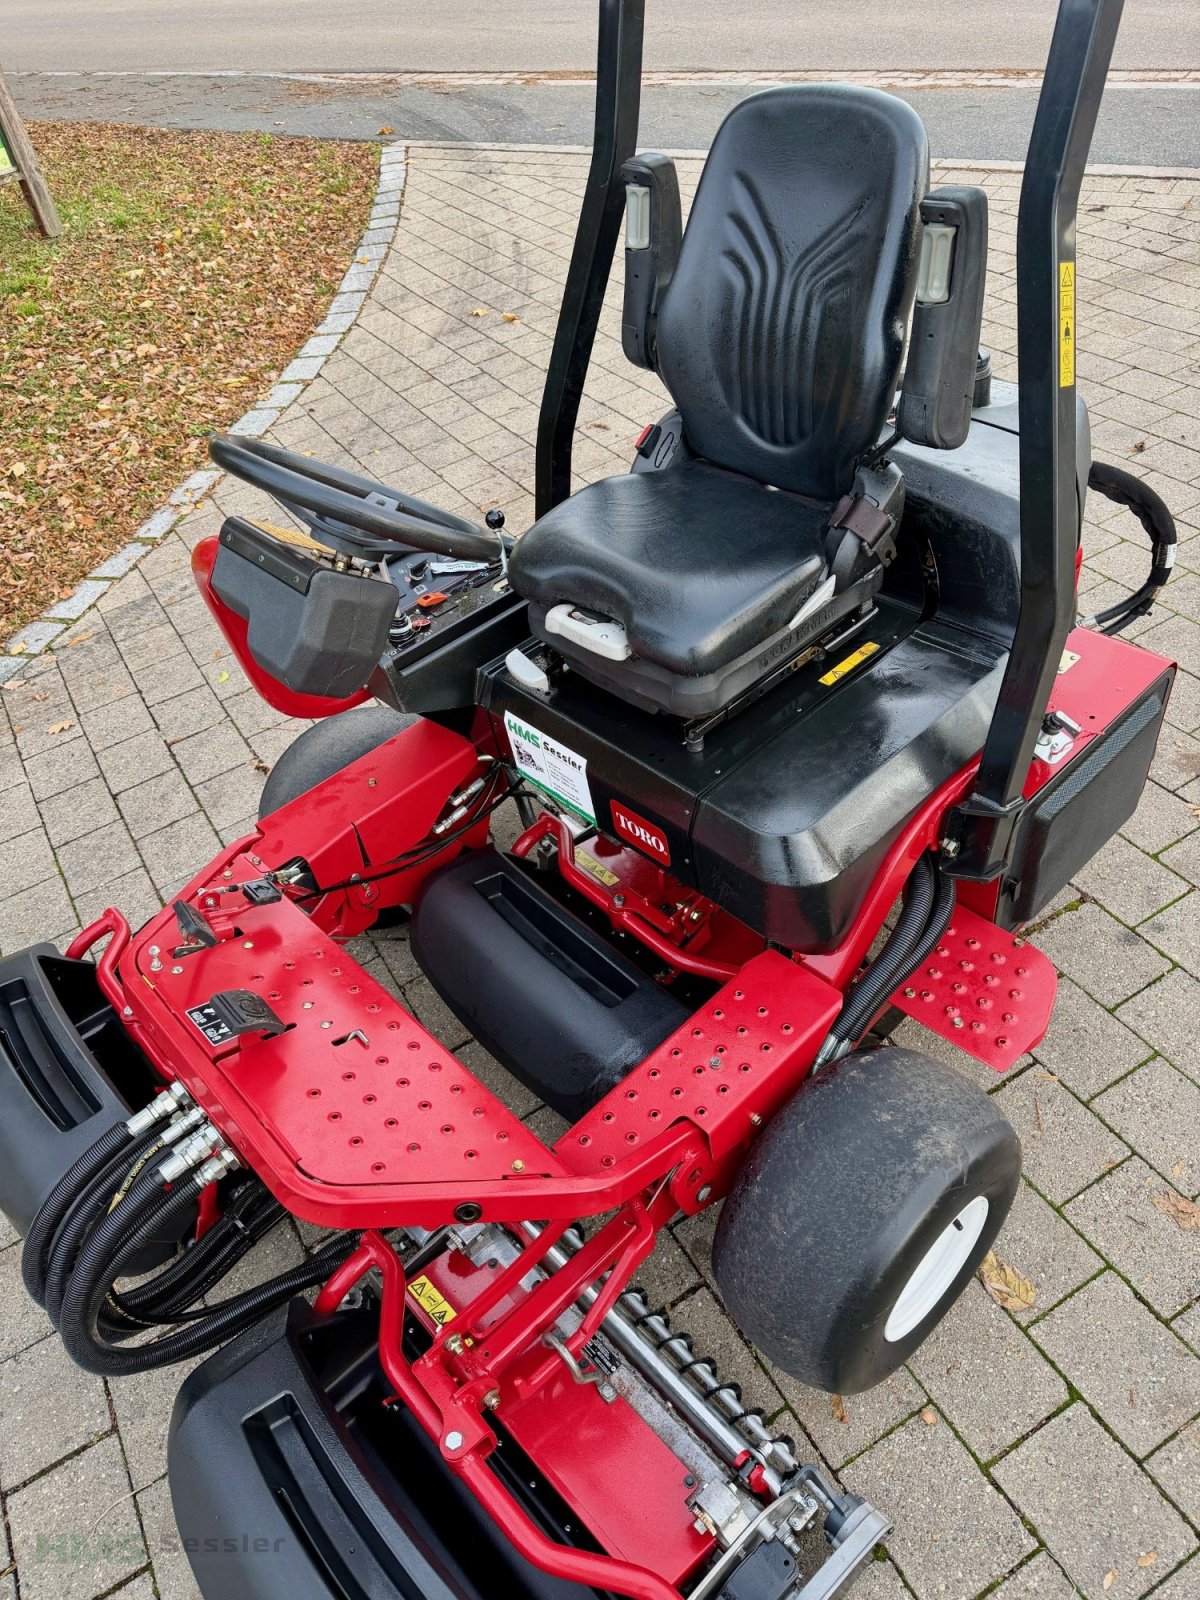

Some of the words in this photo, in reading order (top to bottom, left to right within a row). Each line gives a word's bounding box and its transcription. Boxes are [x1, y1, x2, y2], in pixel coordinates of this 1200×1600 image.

[507, 718, 541, 749] HMS
[543, 741, 583, 772] Sessler
[144, 1146, 158, 1159] MPa
